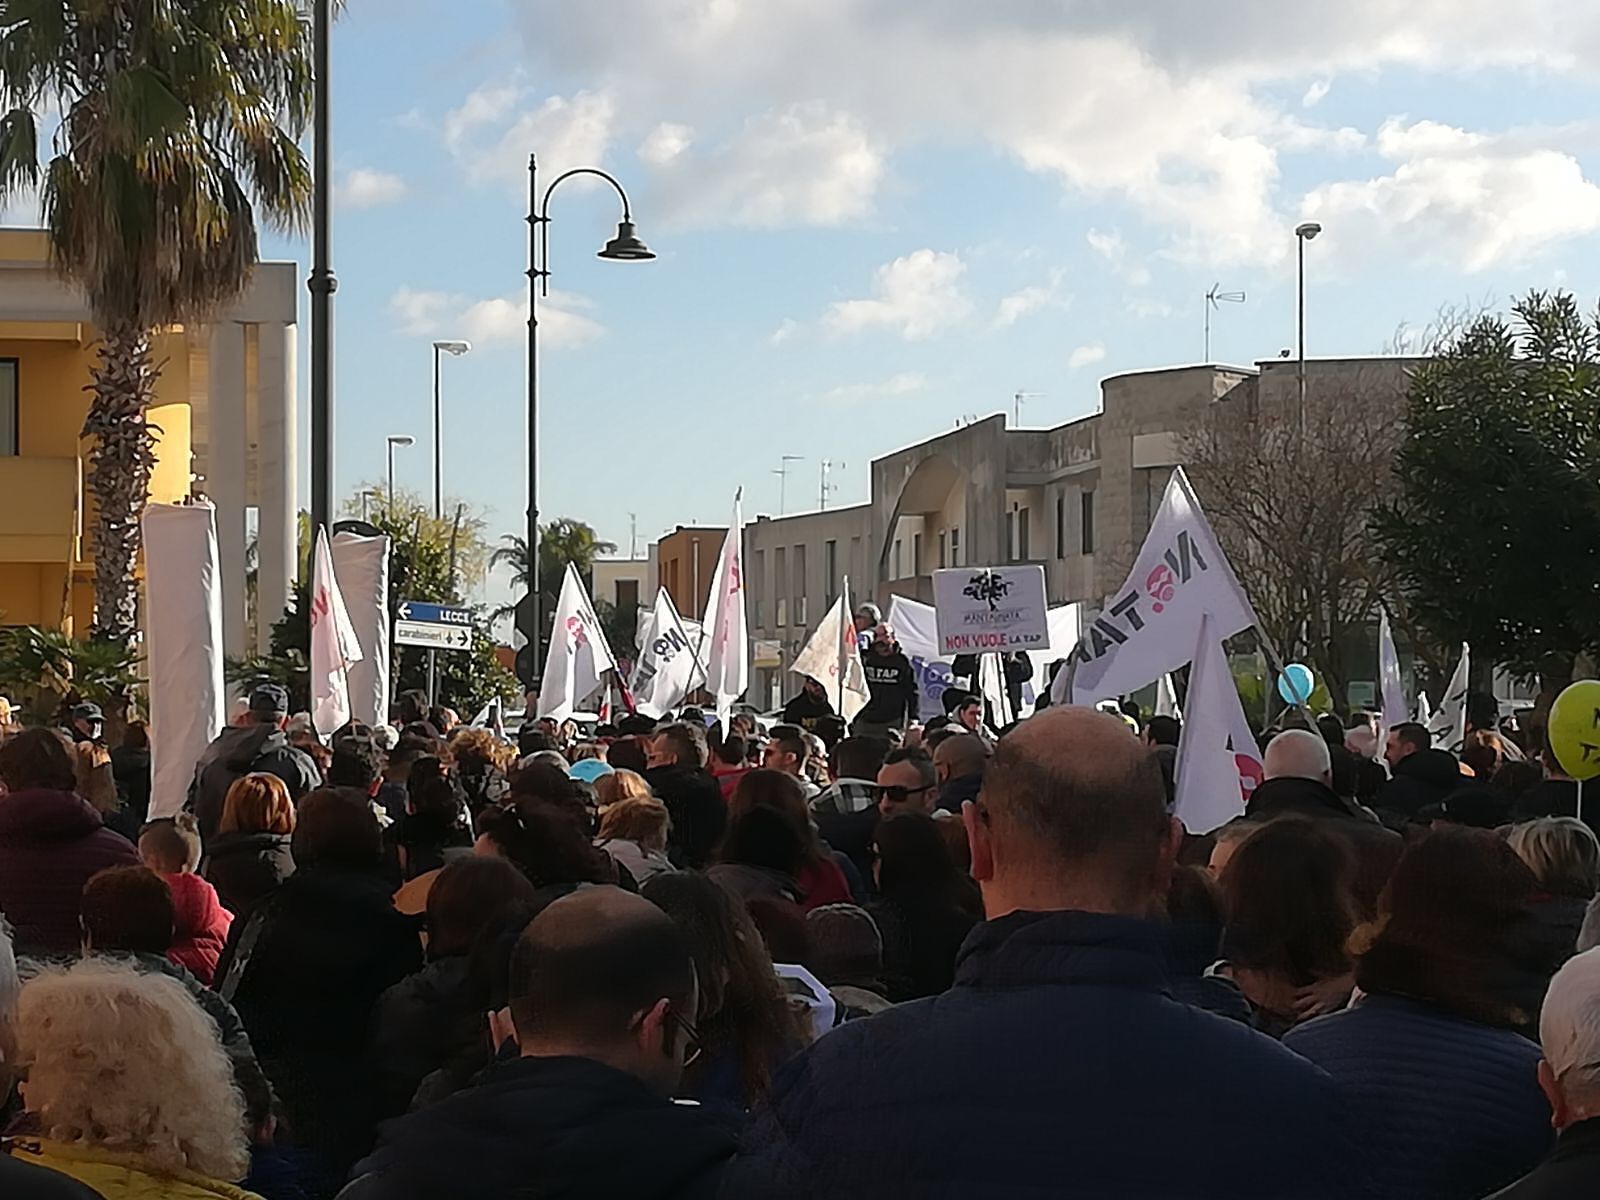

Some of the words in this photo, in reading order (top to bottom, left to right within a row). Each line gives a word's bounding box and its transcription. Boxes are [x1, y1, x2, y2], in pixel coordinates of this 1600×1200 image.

[440, 609, 470, 623] LECCE
[945, 634, 969, 649] NON
[972, 633, 1008, 647] VUOLE
[1009, 635, 1021, 644] LA
[1024, 634, 1042, 642] TAP
[876, 668, 899, 679] TAP
